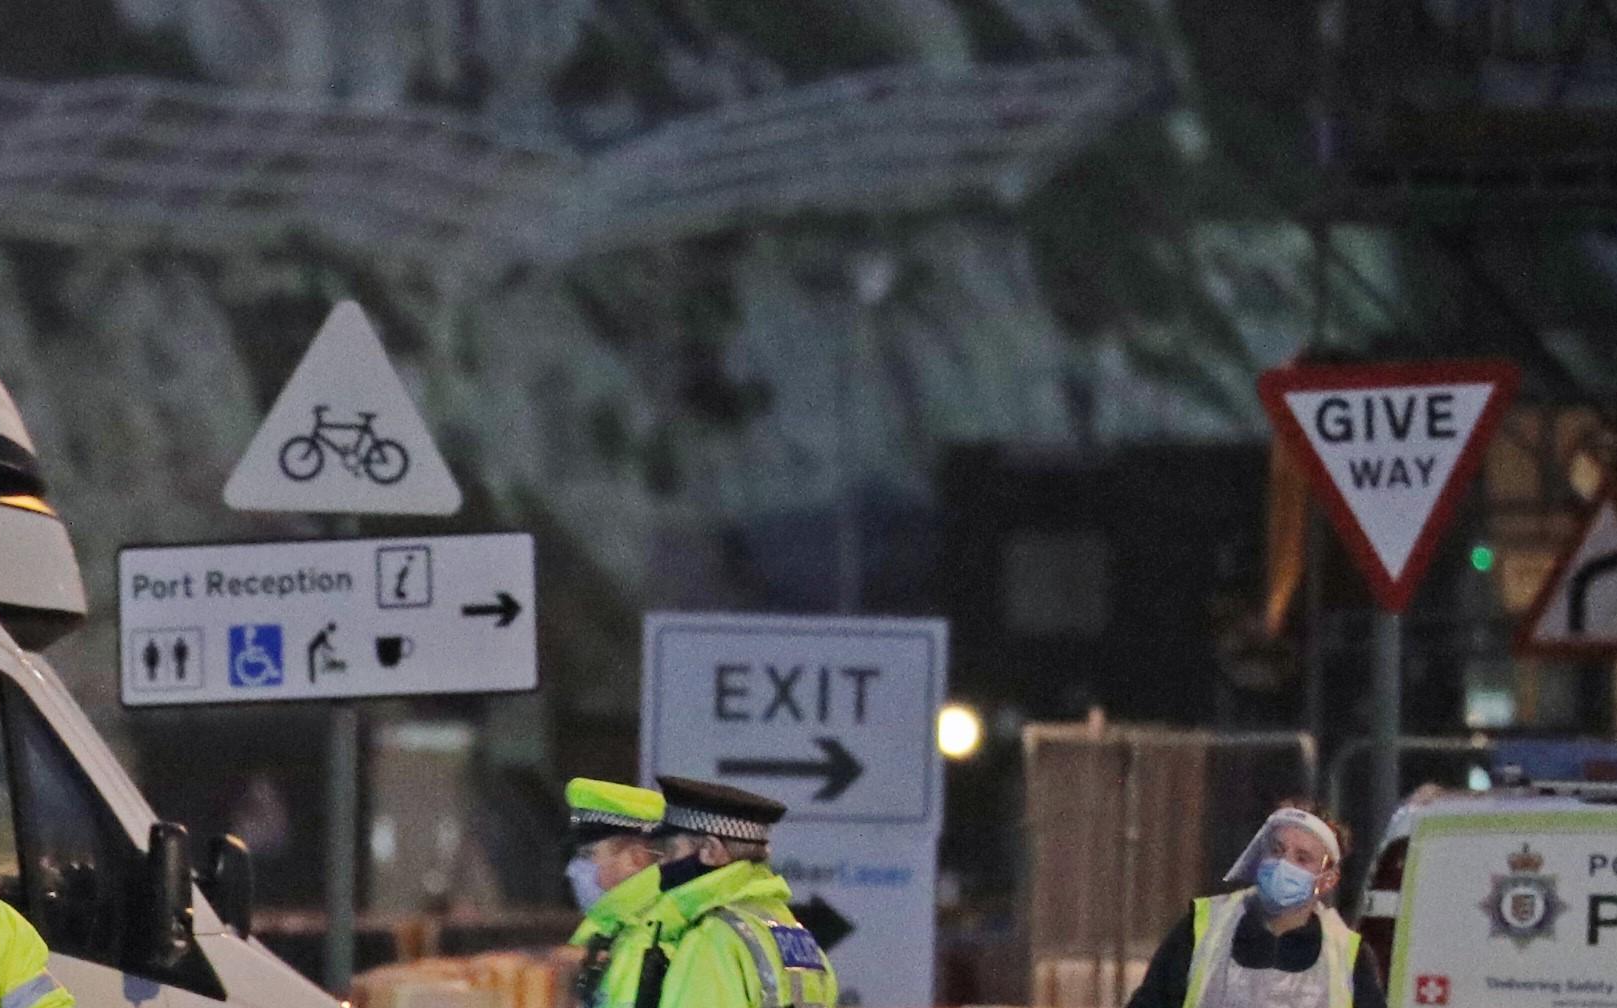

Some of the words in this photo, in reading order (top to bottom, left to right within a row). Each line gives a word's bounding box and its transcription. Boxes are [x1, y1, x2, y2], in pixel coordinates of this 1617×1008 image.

[1315, 394, 1457, 443] GIVE
[1349, 457, 1435, 489] WAY
[131, 572, 193, 600] Port
[205, 567, 353, 598] Reception
[714, 664, 882, 724] EXIT
